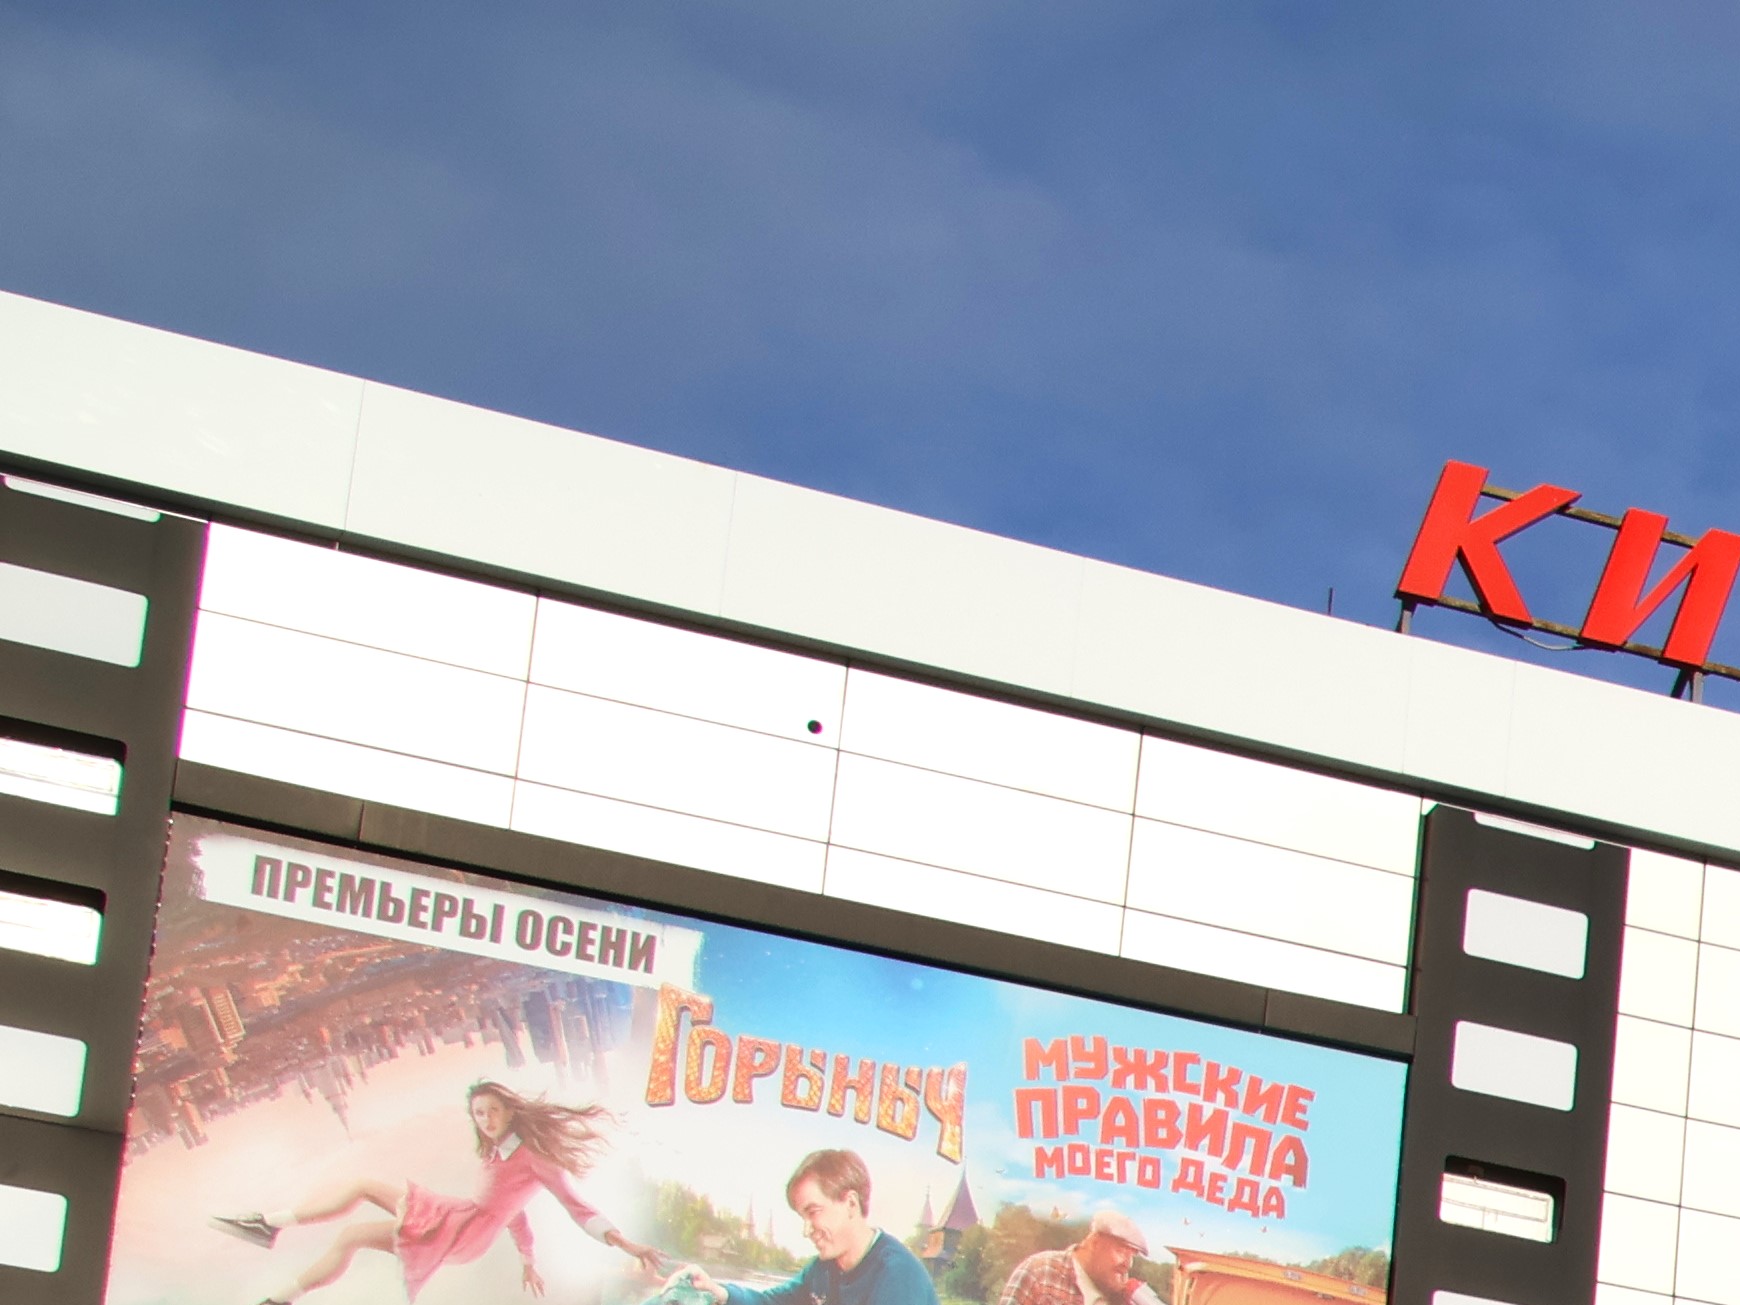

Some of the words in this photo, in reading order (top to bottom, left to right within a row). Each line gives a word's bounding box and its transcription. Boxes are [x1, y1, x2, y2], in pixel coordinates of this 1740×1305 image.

[250, 853, 505, 944] ПРЕМЬЕРЫ
[514, 908, 658, 975] ОСЕНИ
[645, 982, 968, 1165] ГОРЫНЫЧ
[1023, 1035, 1316, 1131] МУЖСКИЕ
[1014, 1085, 1309, 1189] ПРАВИЛА
[1034, 1143, 1161, 1189] МОЕГО
[1171, 1157, 1286, 1219] ДЕДА
